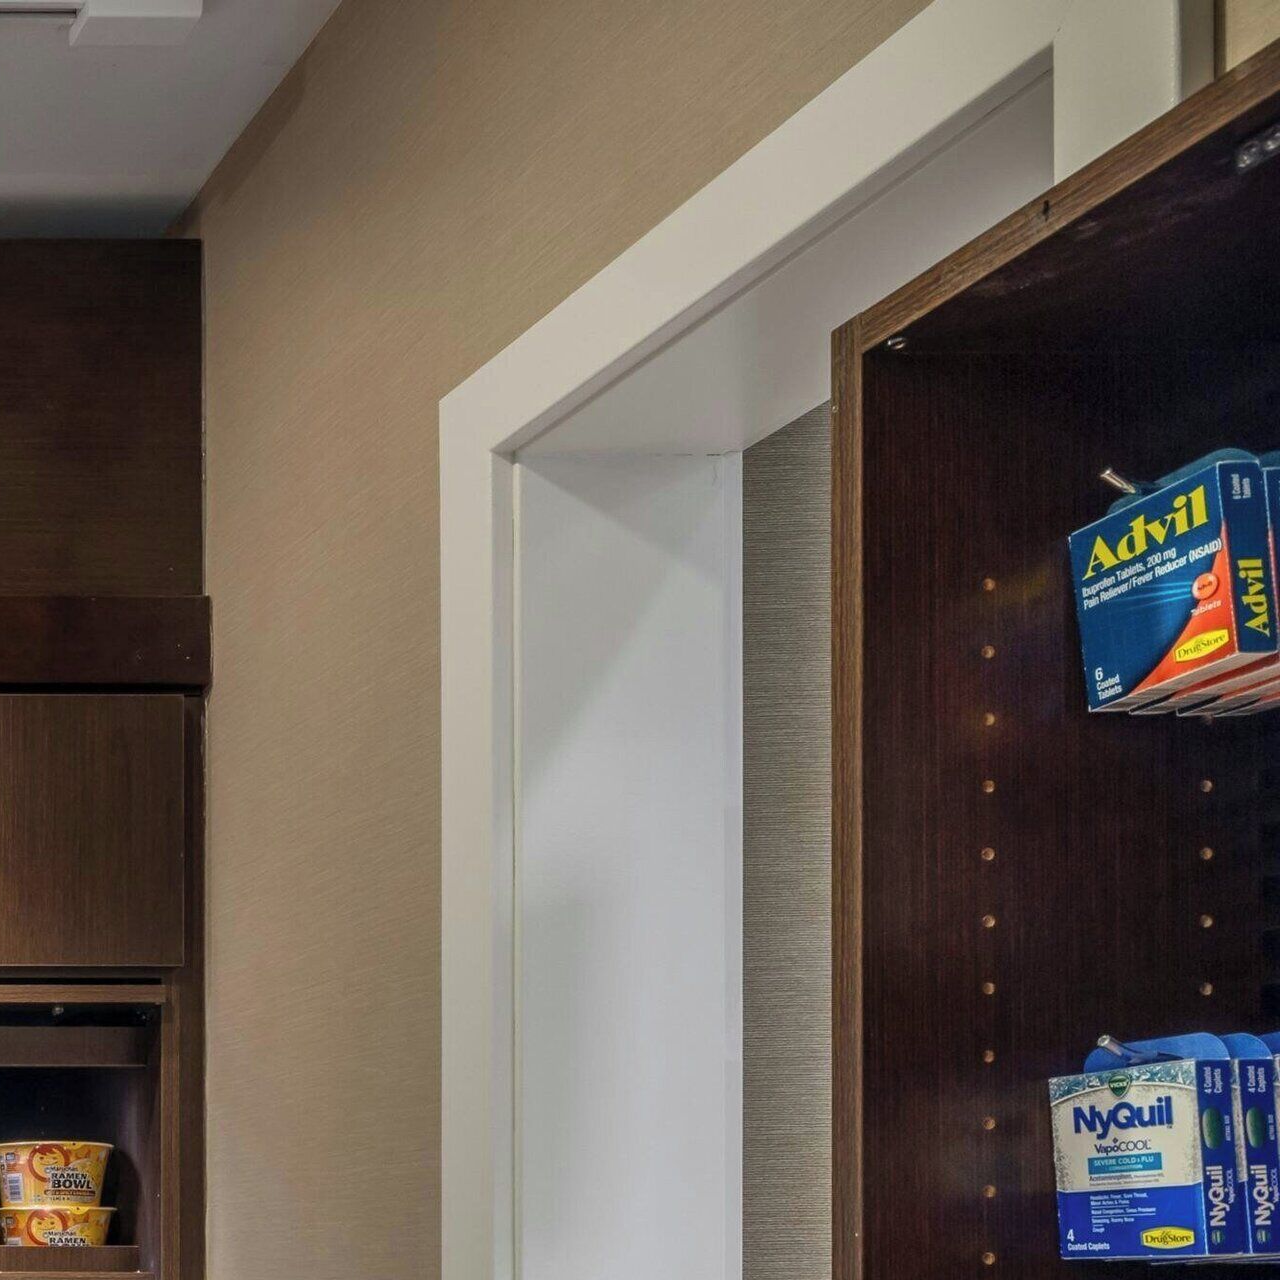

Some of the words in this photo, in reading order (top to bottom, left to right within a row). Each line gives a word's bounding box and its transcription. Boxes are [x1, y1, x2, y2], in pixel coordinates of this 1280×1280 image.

[1082, 485, 1209, 581] Advil
[1081, 575, 1116, 598] Ibuprofen
[1146, 551, 1162, 568] 200
[1083, 597, 1100, 611] Pain
[1154, 554, 1188, 577] Reducer
[1188, 537, 1223, 563] (NSAID)
[1237, 557, 1271, 638] Advil
[1177, 632, 1227, 661] DrugStore
[1095, 667, 1103, 681] 6
[1096, 674, 1120, 691] Coated
[1097, 684, 1123, 702] Tablets
[1213, 1068, 1222, 1094] Caplets
[1072, 1095, 1174, 1140] NyQuil
[1094, 1138, 1151, 1156] VapoCOOL
[1118, 1156, 1136, 1166] COLD
[50, 1172, 88, 1180] RAMEN
[51, 1180, 92, 1190] BOWL
[1205, 1165, 1230, 1228] NyQuil
[1249, 1164, 1275, 1226] NyQuil
[49, 1236, 87, 1244] RAMEN
[1066, 1228, 1075, 1241] 4
[1144, 1231, 1192, 1246] DrugStore
[1067, 1241, 1088, 1252] Coated
[1088, 1240, 1111, 1251] Caplets
